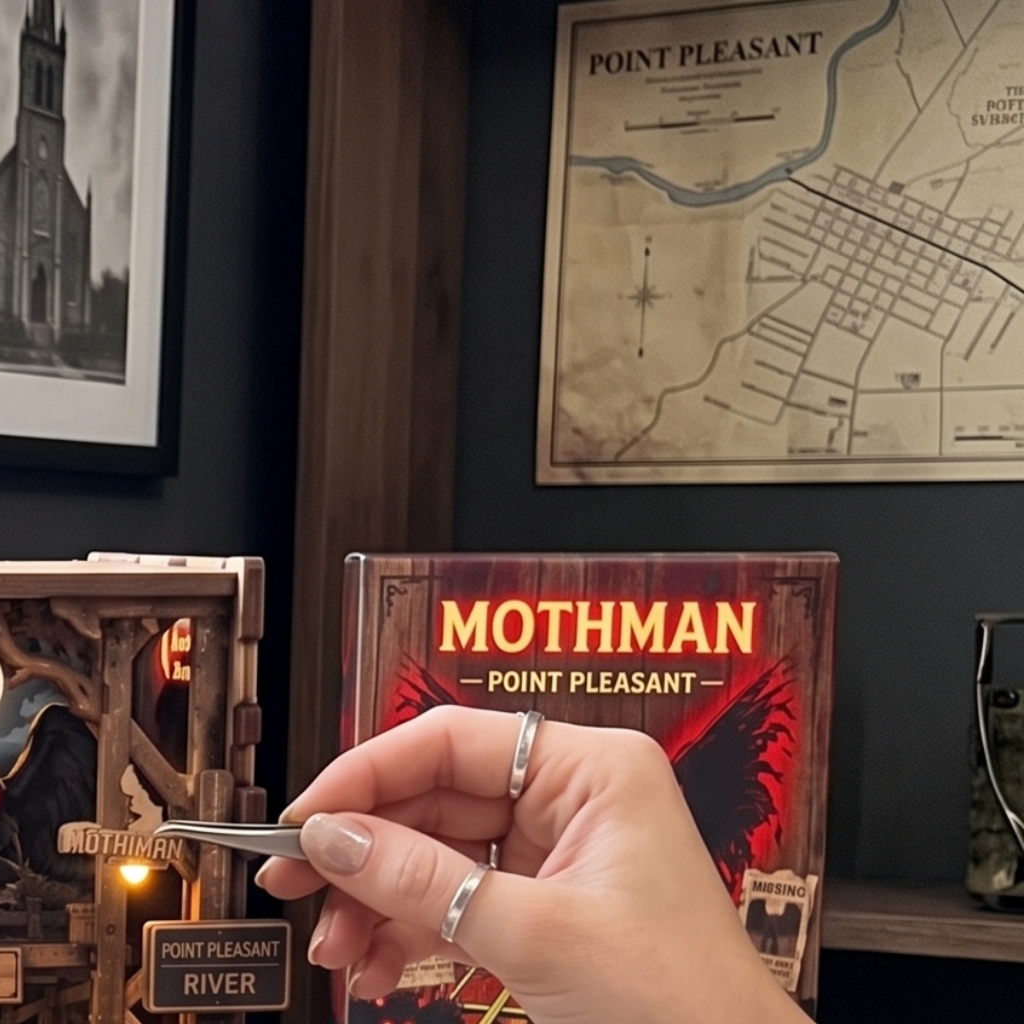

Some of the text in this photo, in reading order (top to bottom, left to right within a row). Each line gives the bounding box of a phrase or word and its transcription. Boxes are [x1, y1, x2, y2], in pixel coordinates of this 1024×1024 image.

[589, 46, 672, 76] POINT
[678, 31, 824, 67] PLEASANT
[439, 599, 757, 655] MOTHMAN
[488, 670, 697, 694] POINT PLEASANT
[162, 940, 280, 960] POINT PLEASANT
[184, 973, 256, 995] RIVER
